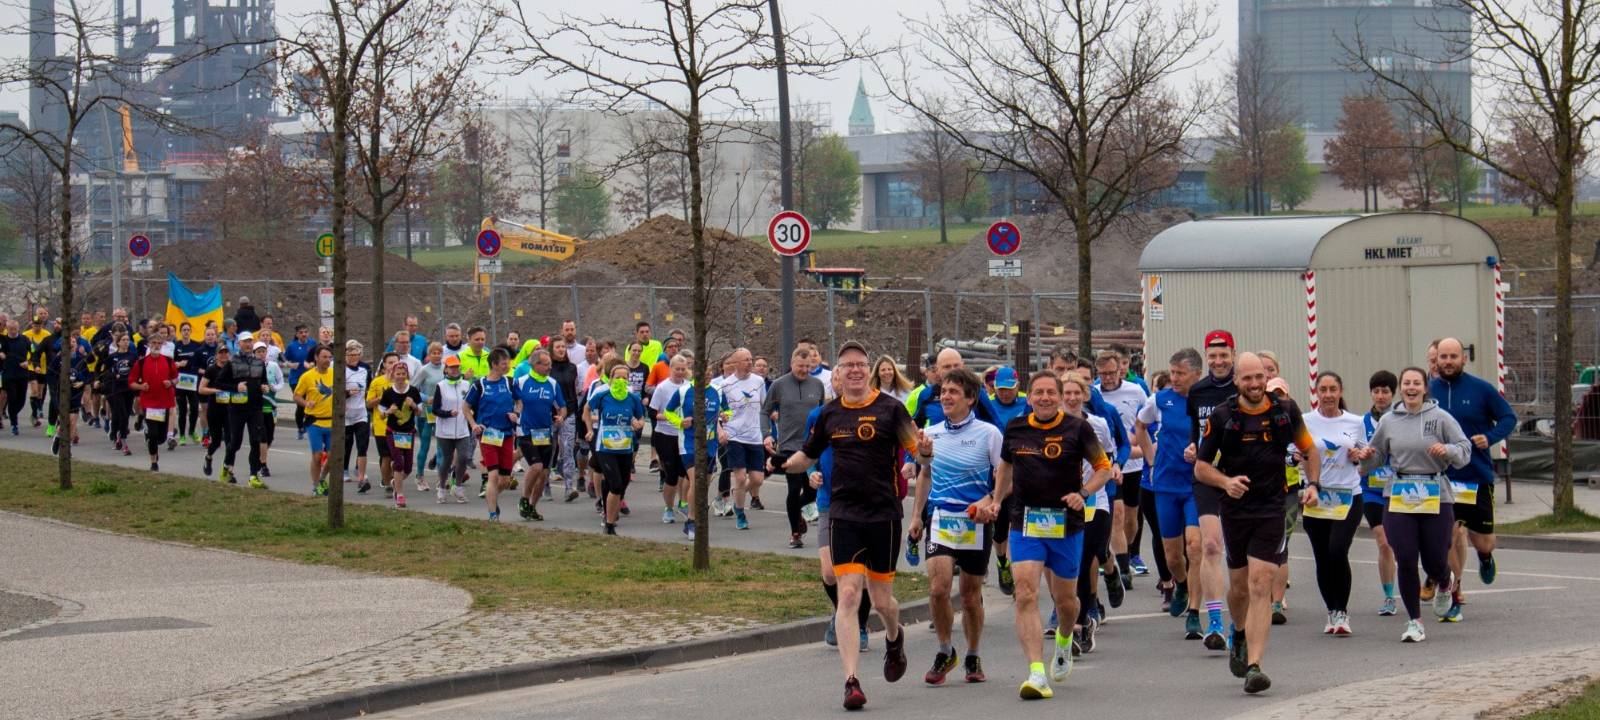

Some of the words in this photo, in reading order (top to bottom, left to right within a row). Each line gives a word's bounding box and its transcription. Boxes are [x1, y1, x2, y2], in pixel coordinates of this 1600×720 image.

[777, 223, 802, 243] 30
[323, 239, 332, 253] H
[521, 242, 566, 253] KOMATSU
[1365, 248, 1385, 259] HKL
